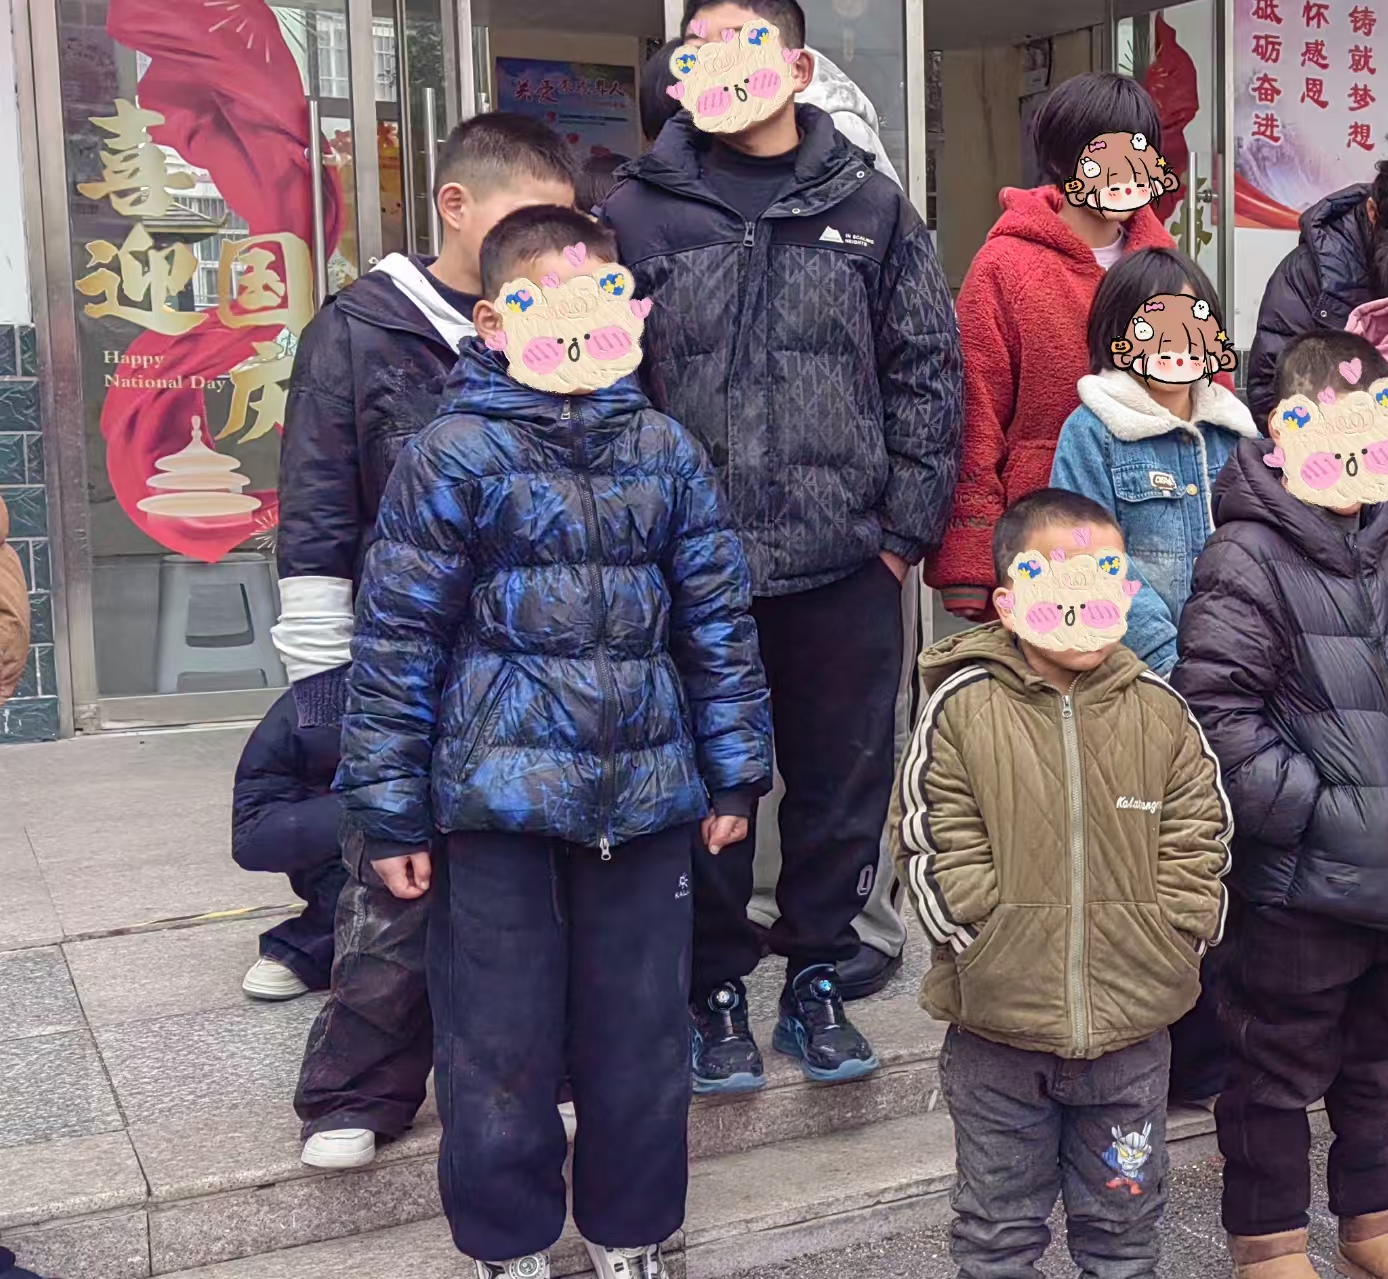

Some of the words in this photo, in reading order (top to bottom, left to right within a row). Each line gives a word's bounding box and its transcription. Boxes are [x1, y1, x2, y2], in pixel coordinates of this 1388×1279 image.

[1251, 0, 1284, 144] 砥砺奋进
[1300, 0, 1330, 110] 怀感恩
[1346, 4, 1377, 152] 铸就梦想
[103, 350, 165, 370] Happy
[103, 374, 183, 390] National
[190, 375, 227, 391] Day
